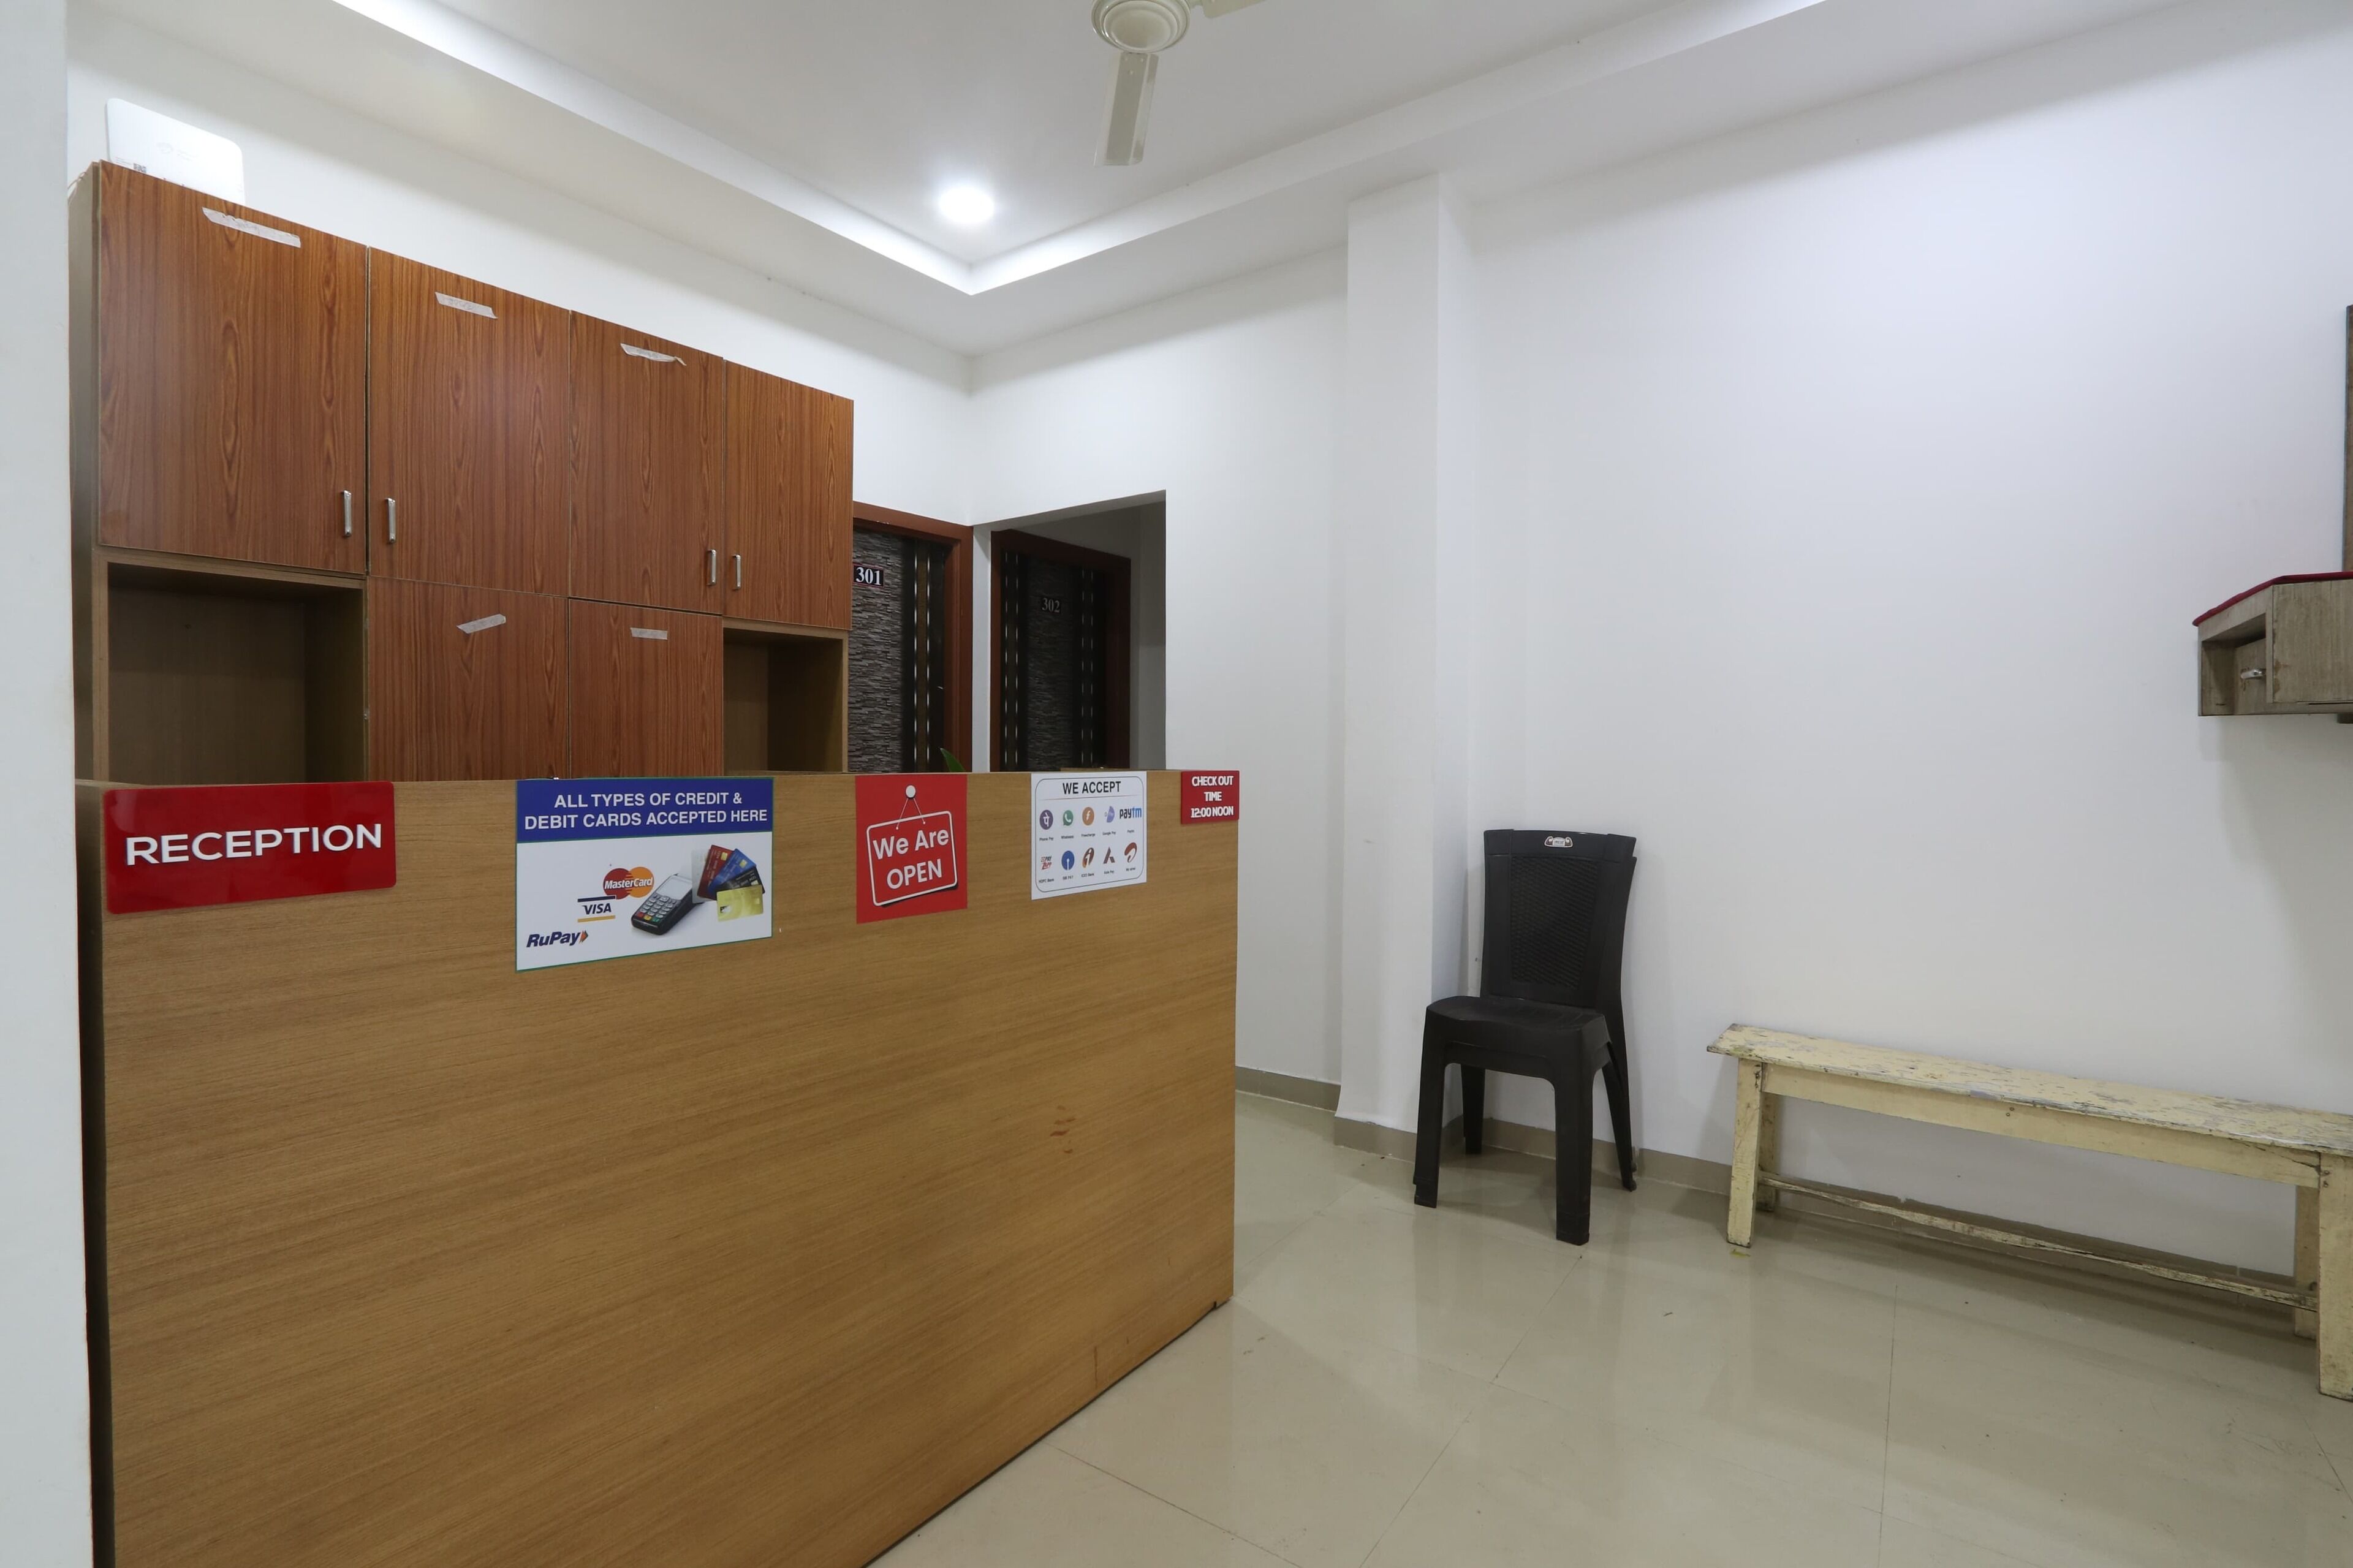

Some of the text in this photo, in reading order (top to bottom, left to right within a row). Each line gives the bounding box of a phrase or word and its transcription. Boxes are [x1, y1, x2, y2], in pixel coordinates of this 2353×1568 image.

[856, 567, 881, 585] 301
[1042, 597, 1060, 613] 302
[1063, 781, 1121, 795] WE ACCEPT
[1192, 775, 1234, 786] CHECK OUT
[554, 792, 743, 808] ALL TYPES OF CREDIT &
[1203, 791, 1222, 802] TIME
[525, 809, 767, 830] DEBIT CARDS ACCEPTED HERE
[1190, 806, 1234, 818] 12:00 NOON
[126, 824, 382, 866] RECEPTION
[873, 830, 949, 860] We Are
[887, 858, 942, 889] OPEN
[604, 877, 653, 890] MasterCard
[582, 903, 612, 915] VISA
[526, 930, 581, 948] RuPay
